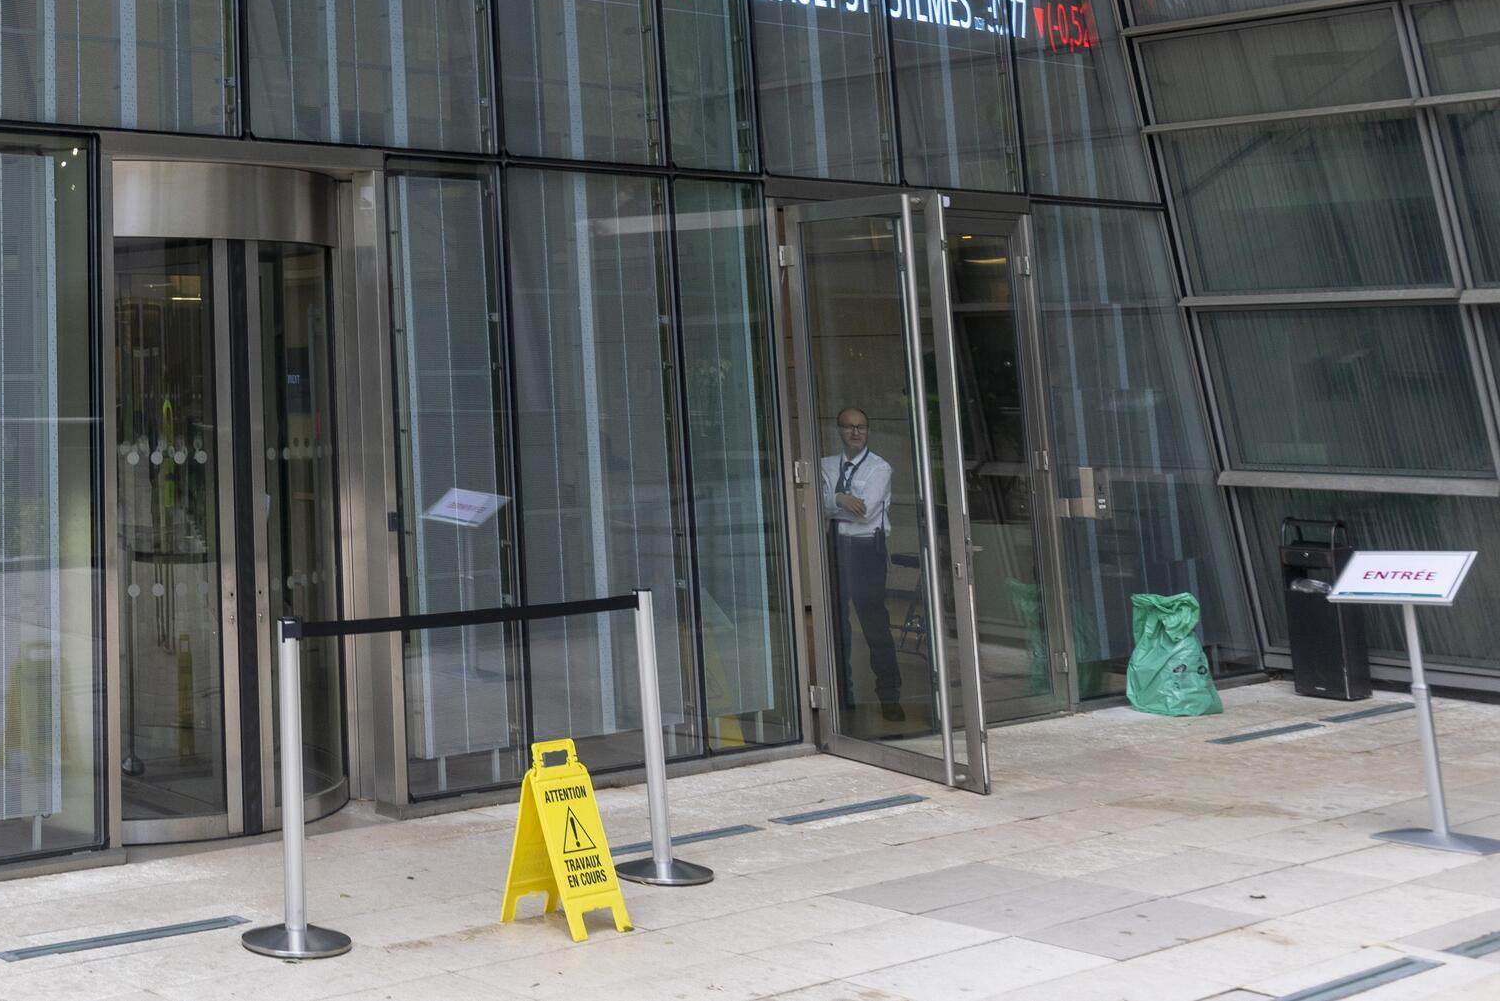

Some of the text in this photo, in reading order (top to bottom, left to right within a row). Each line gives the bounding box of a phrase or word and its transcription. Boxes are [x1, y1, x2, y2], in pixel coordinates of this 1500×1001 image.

[1362, 568, 1437, 581] ENTRÉE
[544, 786, 587, 803] ATTENTION
[565, 854, 602, 873] TRAVAUX
[567, 870, 607, 888] EN COURS
